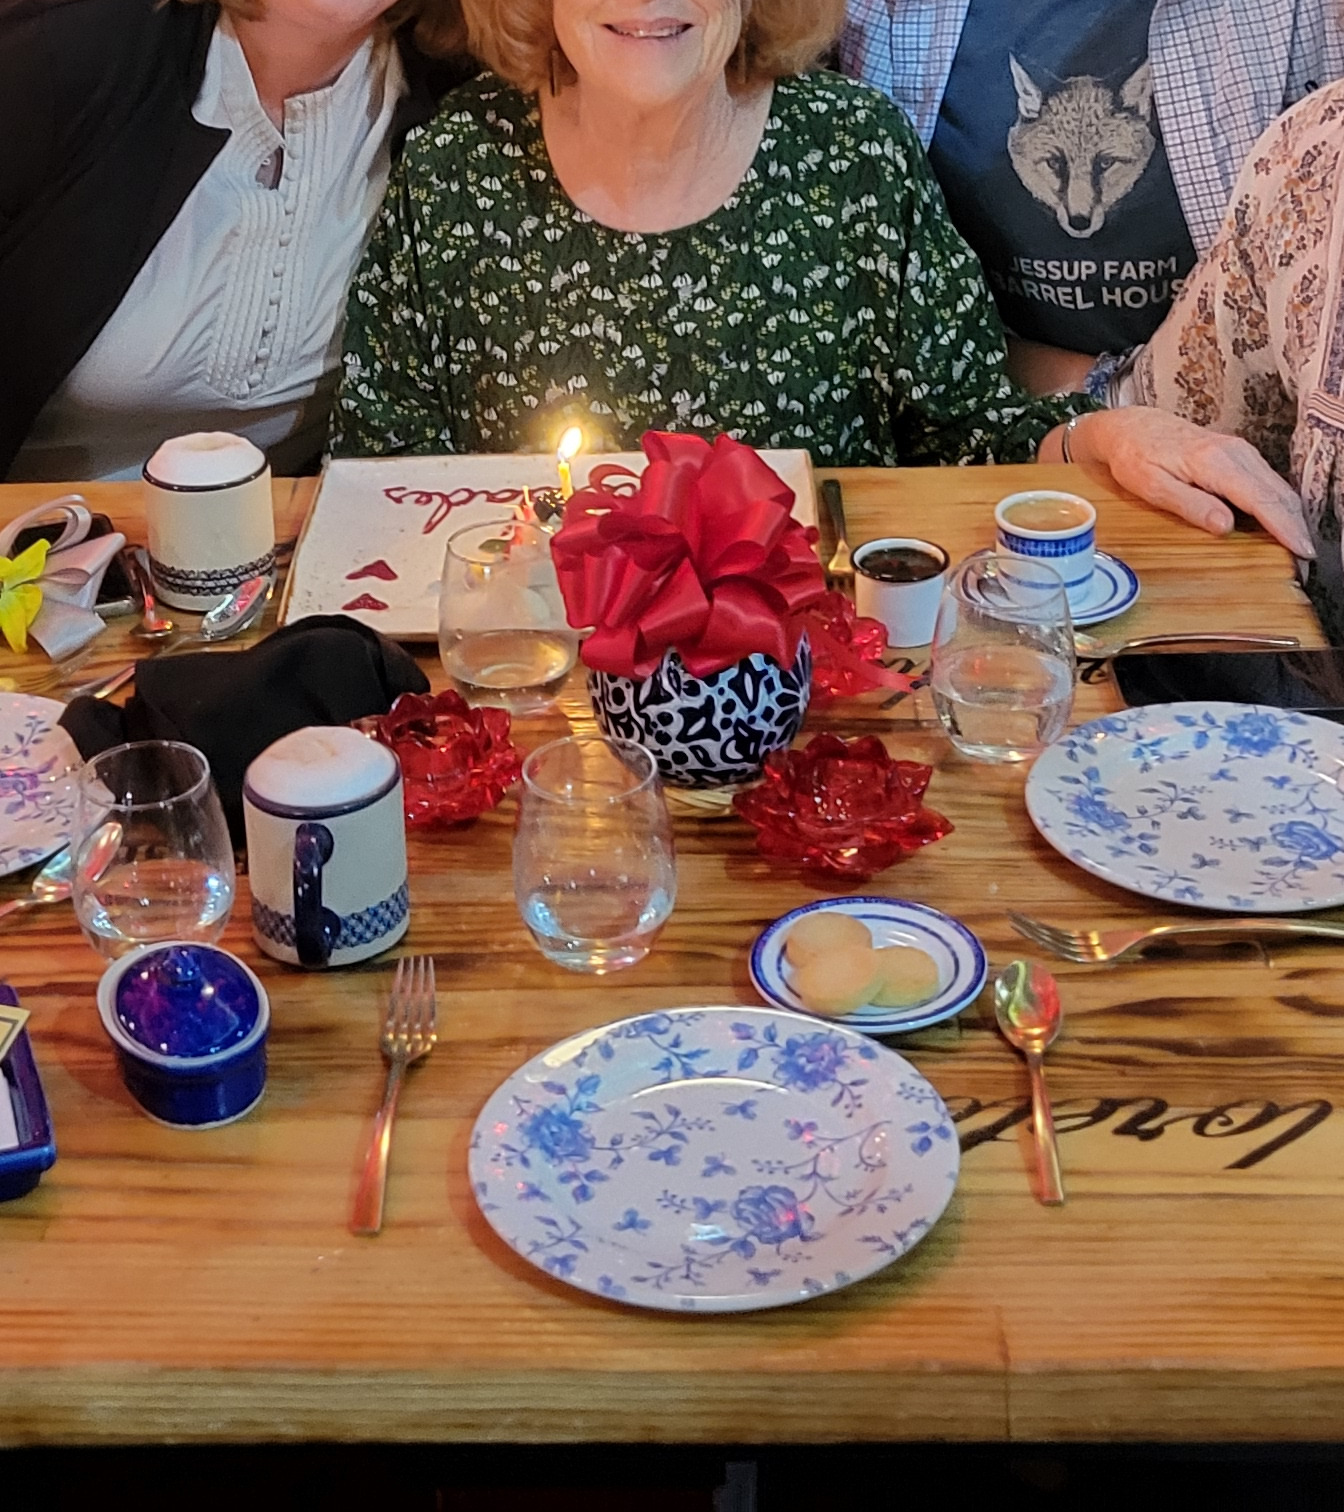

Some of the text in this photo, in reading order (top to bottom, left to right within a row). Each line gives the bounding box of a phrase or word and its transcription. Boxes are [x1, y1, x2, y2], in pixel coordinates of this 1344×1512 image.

[1011, 256, 1177, 281] JESSUP FARM
[1102, 278, 1186, 309] HOUS
